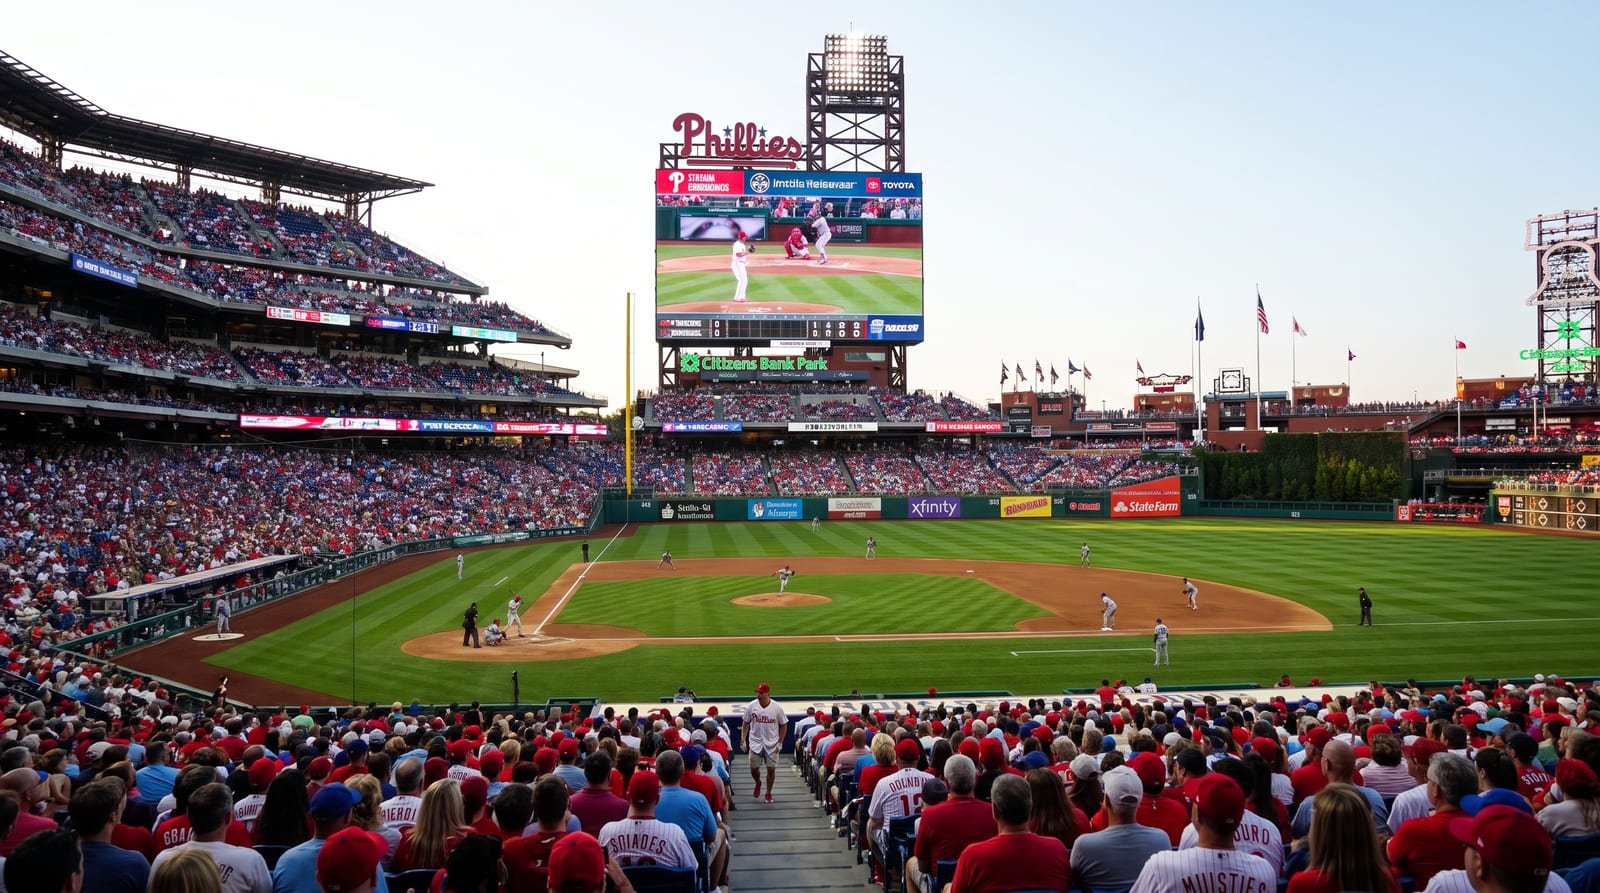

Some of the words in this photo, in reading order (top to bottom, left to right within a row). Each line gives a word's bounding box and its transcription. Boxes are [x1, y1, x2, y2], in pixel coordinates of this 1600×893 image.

[673, 112, 802, 157] Phillies
[882, 182, 915, 190] TOYOTA
[701, 356, 757, 370] Citizens
[759, 356, 795, 370] Bank
[797, 356, 828, 370] Park
[911, 499, 958, 517] xfinity
